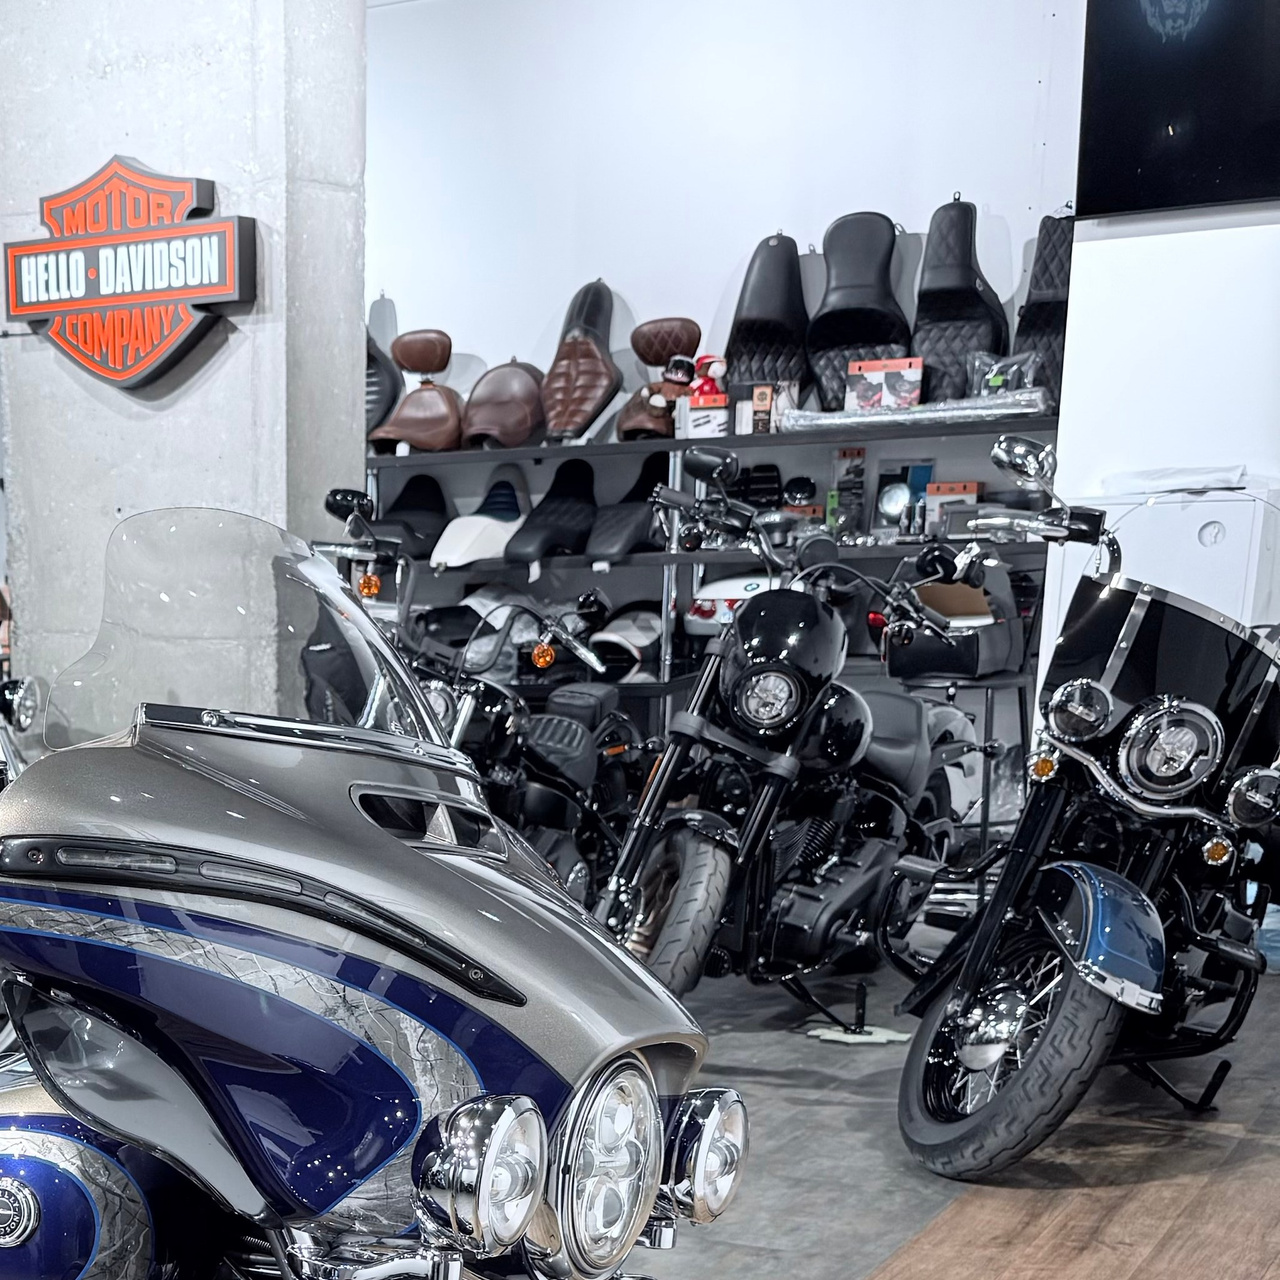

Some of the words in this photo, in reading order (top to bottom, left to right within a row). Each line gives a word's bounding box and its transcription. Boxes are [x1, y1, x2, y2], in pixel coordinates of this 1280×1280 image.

[63, 177, 172, 237] MOTOR
[21, 250, 86, 303] HELLO
[98, 235, 219, 296] DAVIDSON
[65, 303, 175, 369] COMPANY
